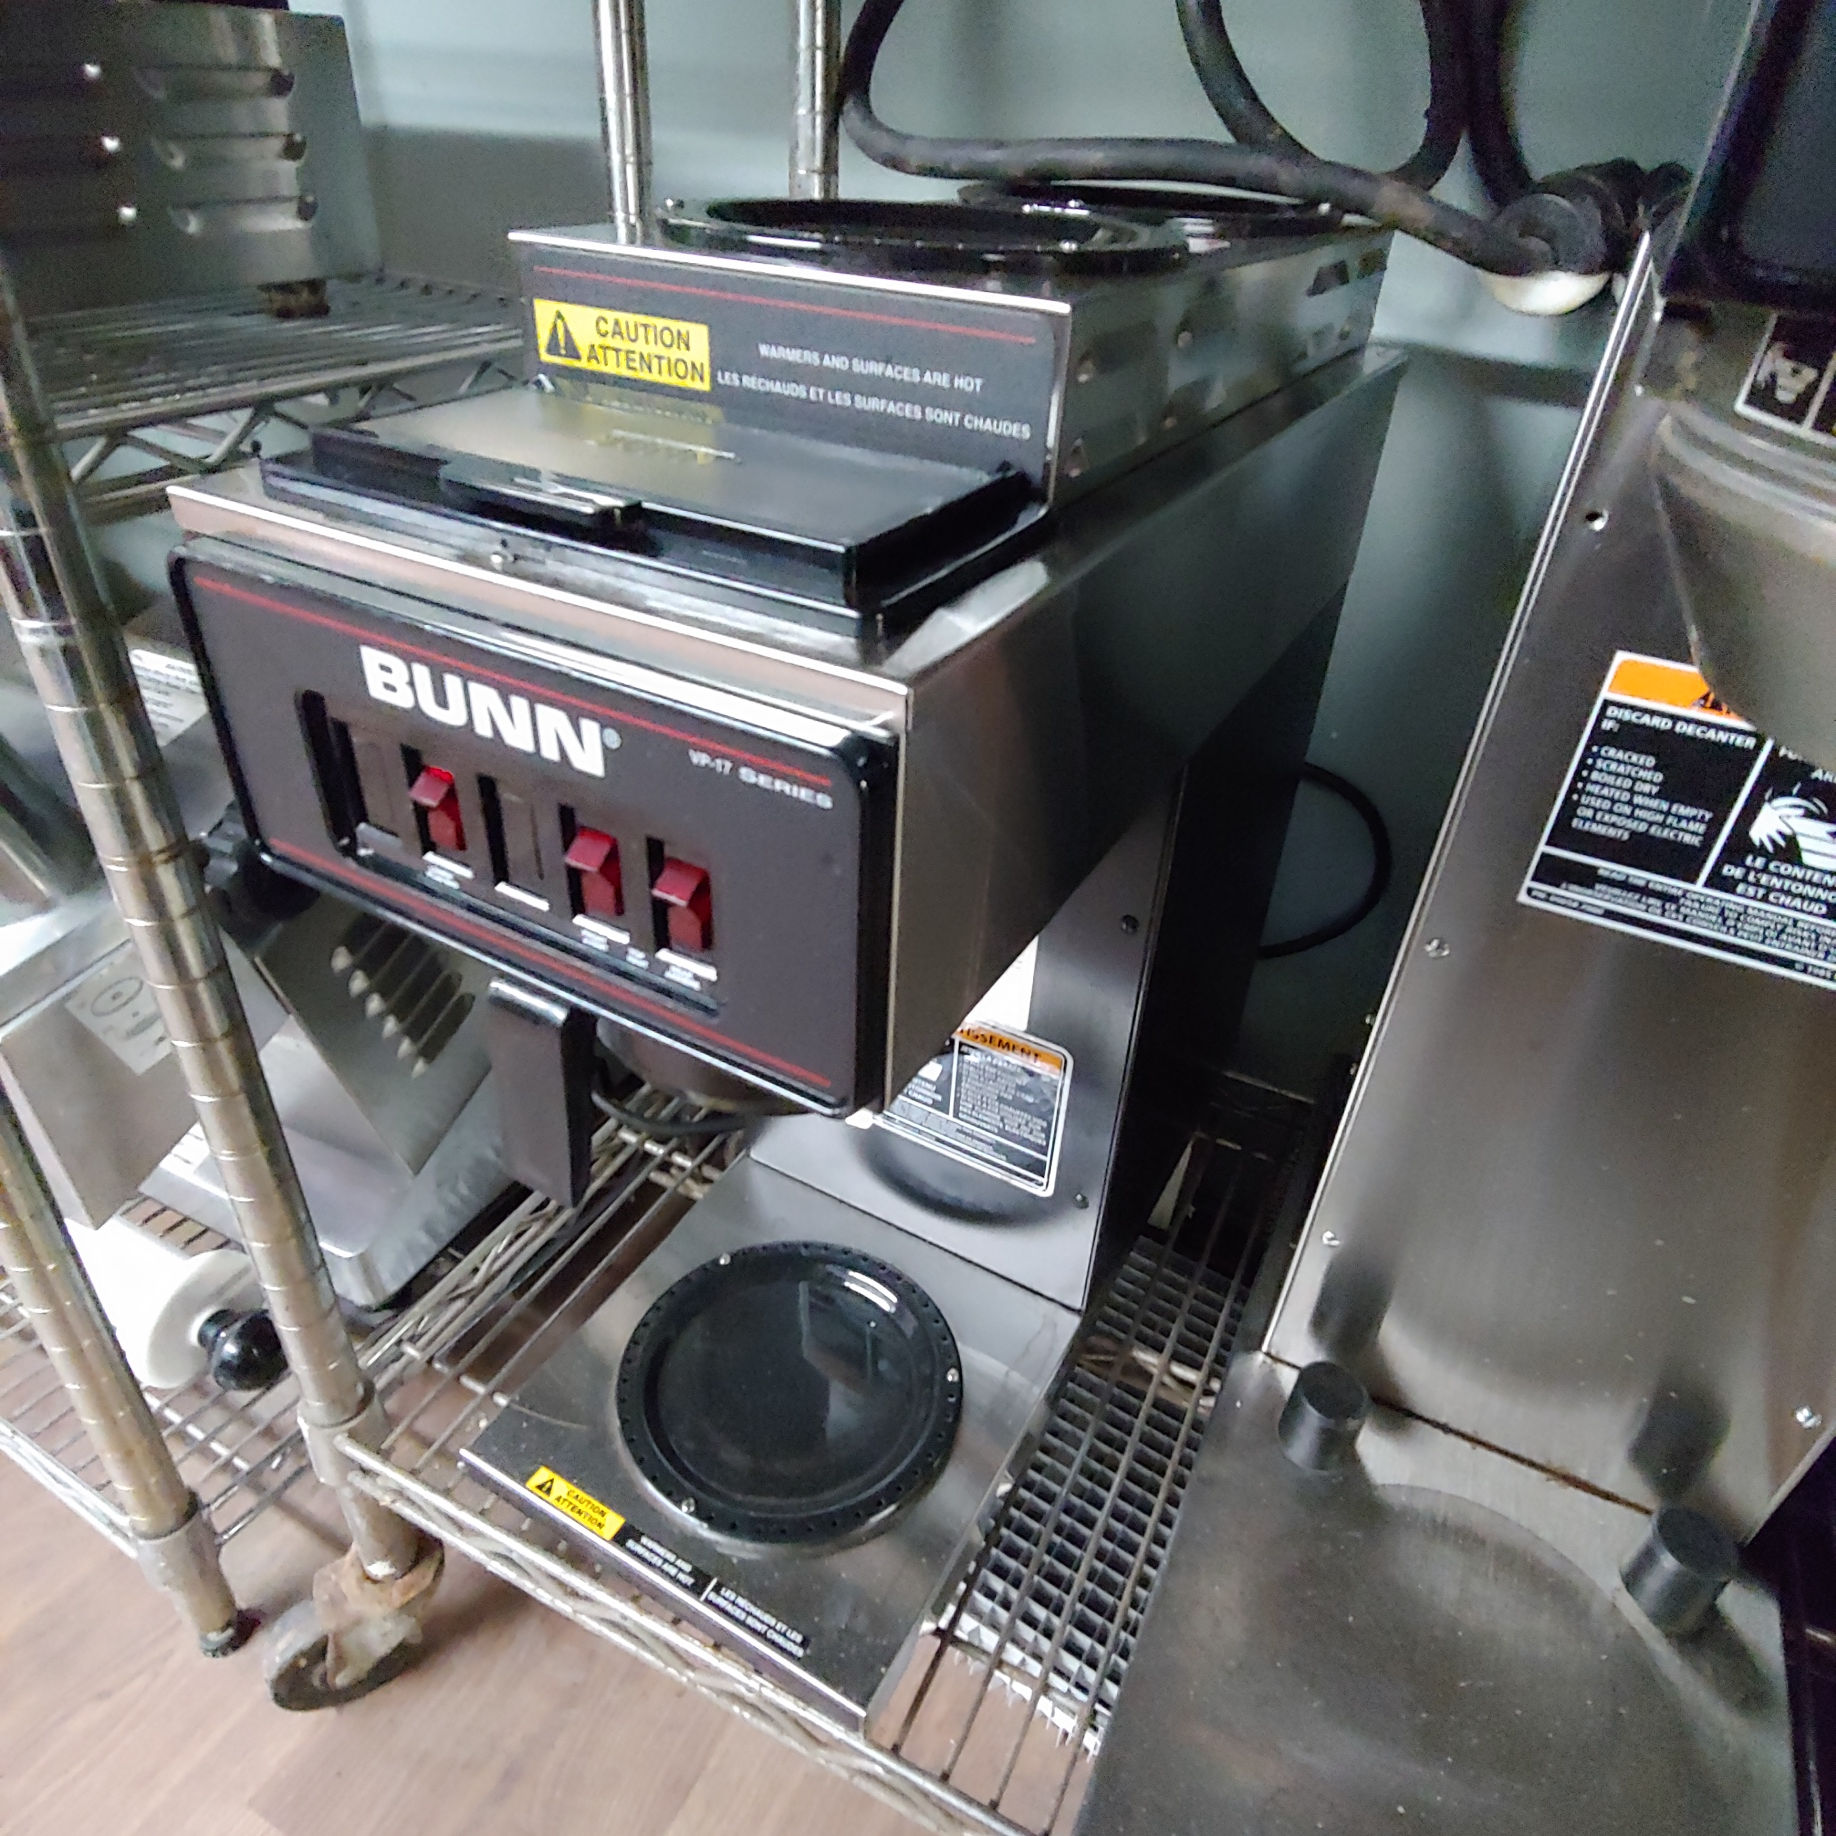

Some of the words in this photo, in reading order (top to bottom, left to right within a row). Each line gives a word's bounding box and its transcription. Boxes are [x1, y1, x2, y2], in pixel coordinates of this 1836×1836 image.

[596, 316, 690, 351] CAUTION
[587, 344, 704, 383] ATTENTION
[758, 343, 820, 366] WARMERS
[823, 354, 849, 370] AND
[852, 357, 921, 383] SURFACES
[923, 369, 951, 388] ARE
[954, 375, 984, 392] HOT
[717, 370, 740, 387] LES
[809, 386, 825, 401] ET
[827, 390, 851, 407] LES
[854, 391, 922, 420] SURFACES
[925, 406, 961, 427] SONT
[964, 414, 1031, 440] CHAUDES
[360, 645, 606, 777] BUNN
[1605, 705, 1673, 731] DISCARD
[1674, 721, 1757, 750] DECANTER
[1595, 758, 1664, 784] SCRATCHED
[1600, 745, 1656, 768] CRACKED
[1590, 770, 1633, 789] BOILED
[1580, 794, 1612, 811] USED
[1613, 802, 1633, 816] ON
[1665, 815, 1708, 835] FLAME
[1585, 782, 1631, 802] HEATED
[1670, 802, 1714, 822] EMPTY
[1722, 864, 1746, 879] DE
[1745, 854, 1767, 869] LE
[1736, 882, 1767, 899] EST
[1768, 892, 1827, 915] CHAUD
[555, 1496, 605, 1530] ATTENTION
[566, 1489, 607, 1518] CAUTION
